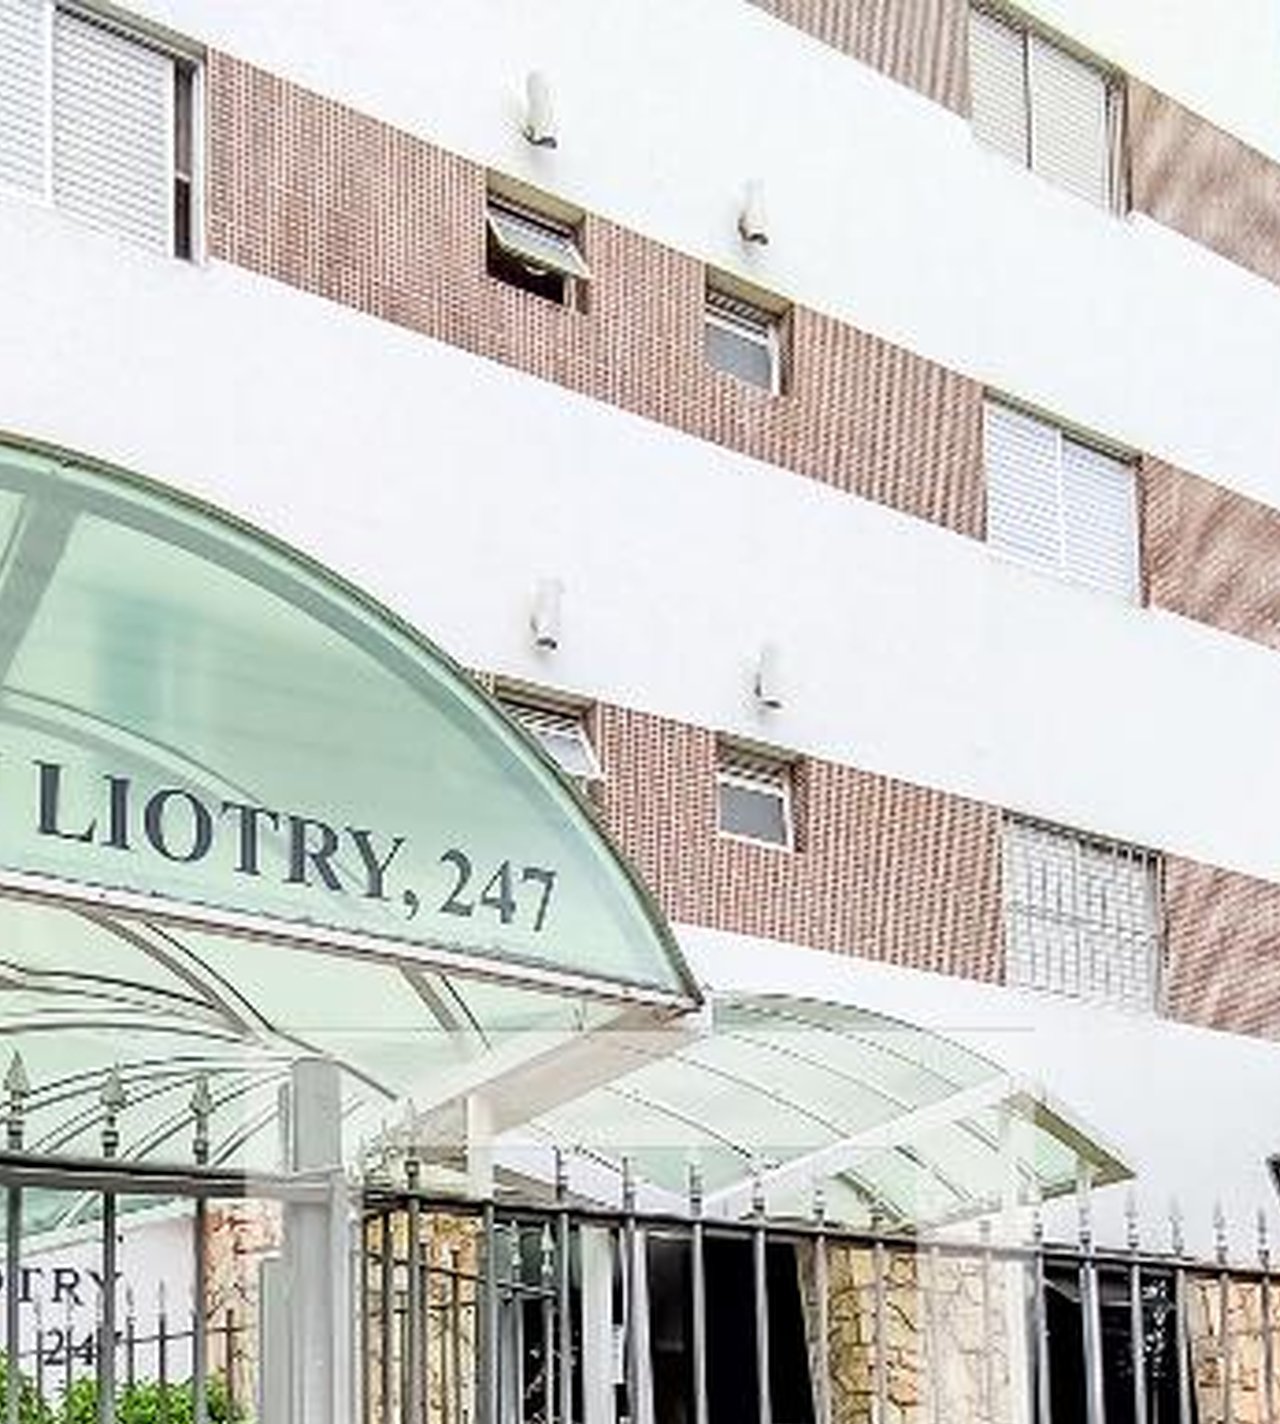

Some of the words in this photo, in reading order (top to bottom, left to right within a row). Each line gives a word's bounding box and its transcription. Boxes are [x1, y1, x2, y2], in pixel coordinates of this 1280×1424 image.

[38, 762, 422, 919] LIOTRY,
[437, 847, 558, 934] 247
[43, 1327, 122, 1366] 24
